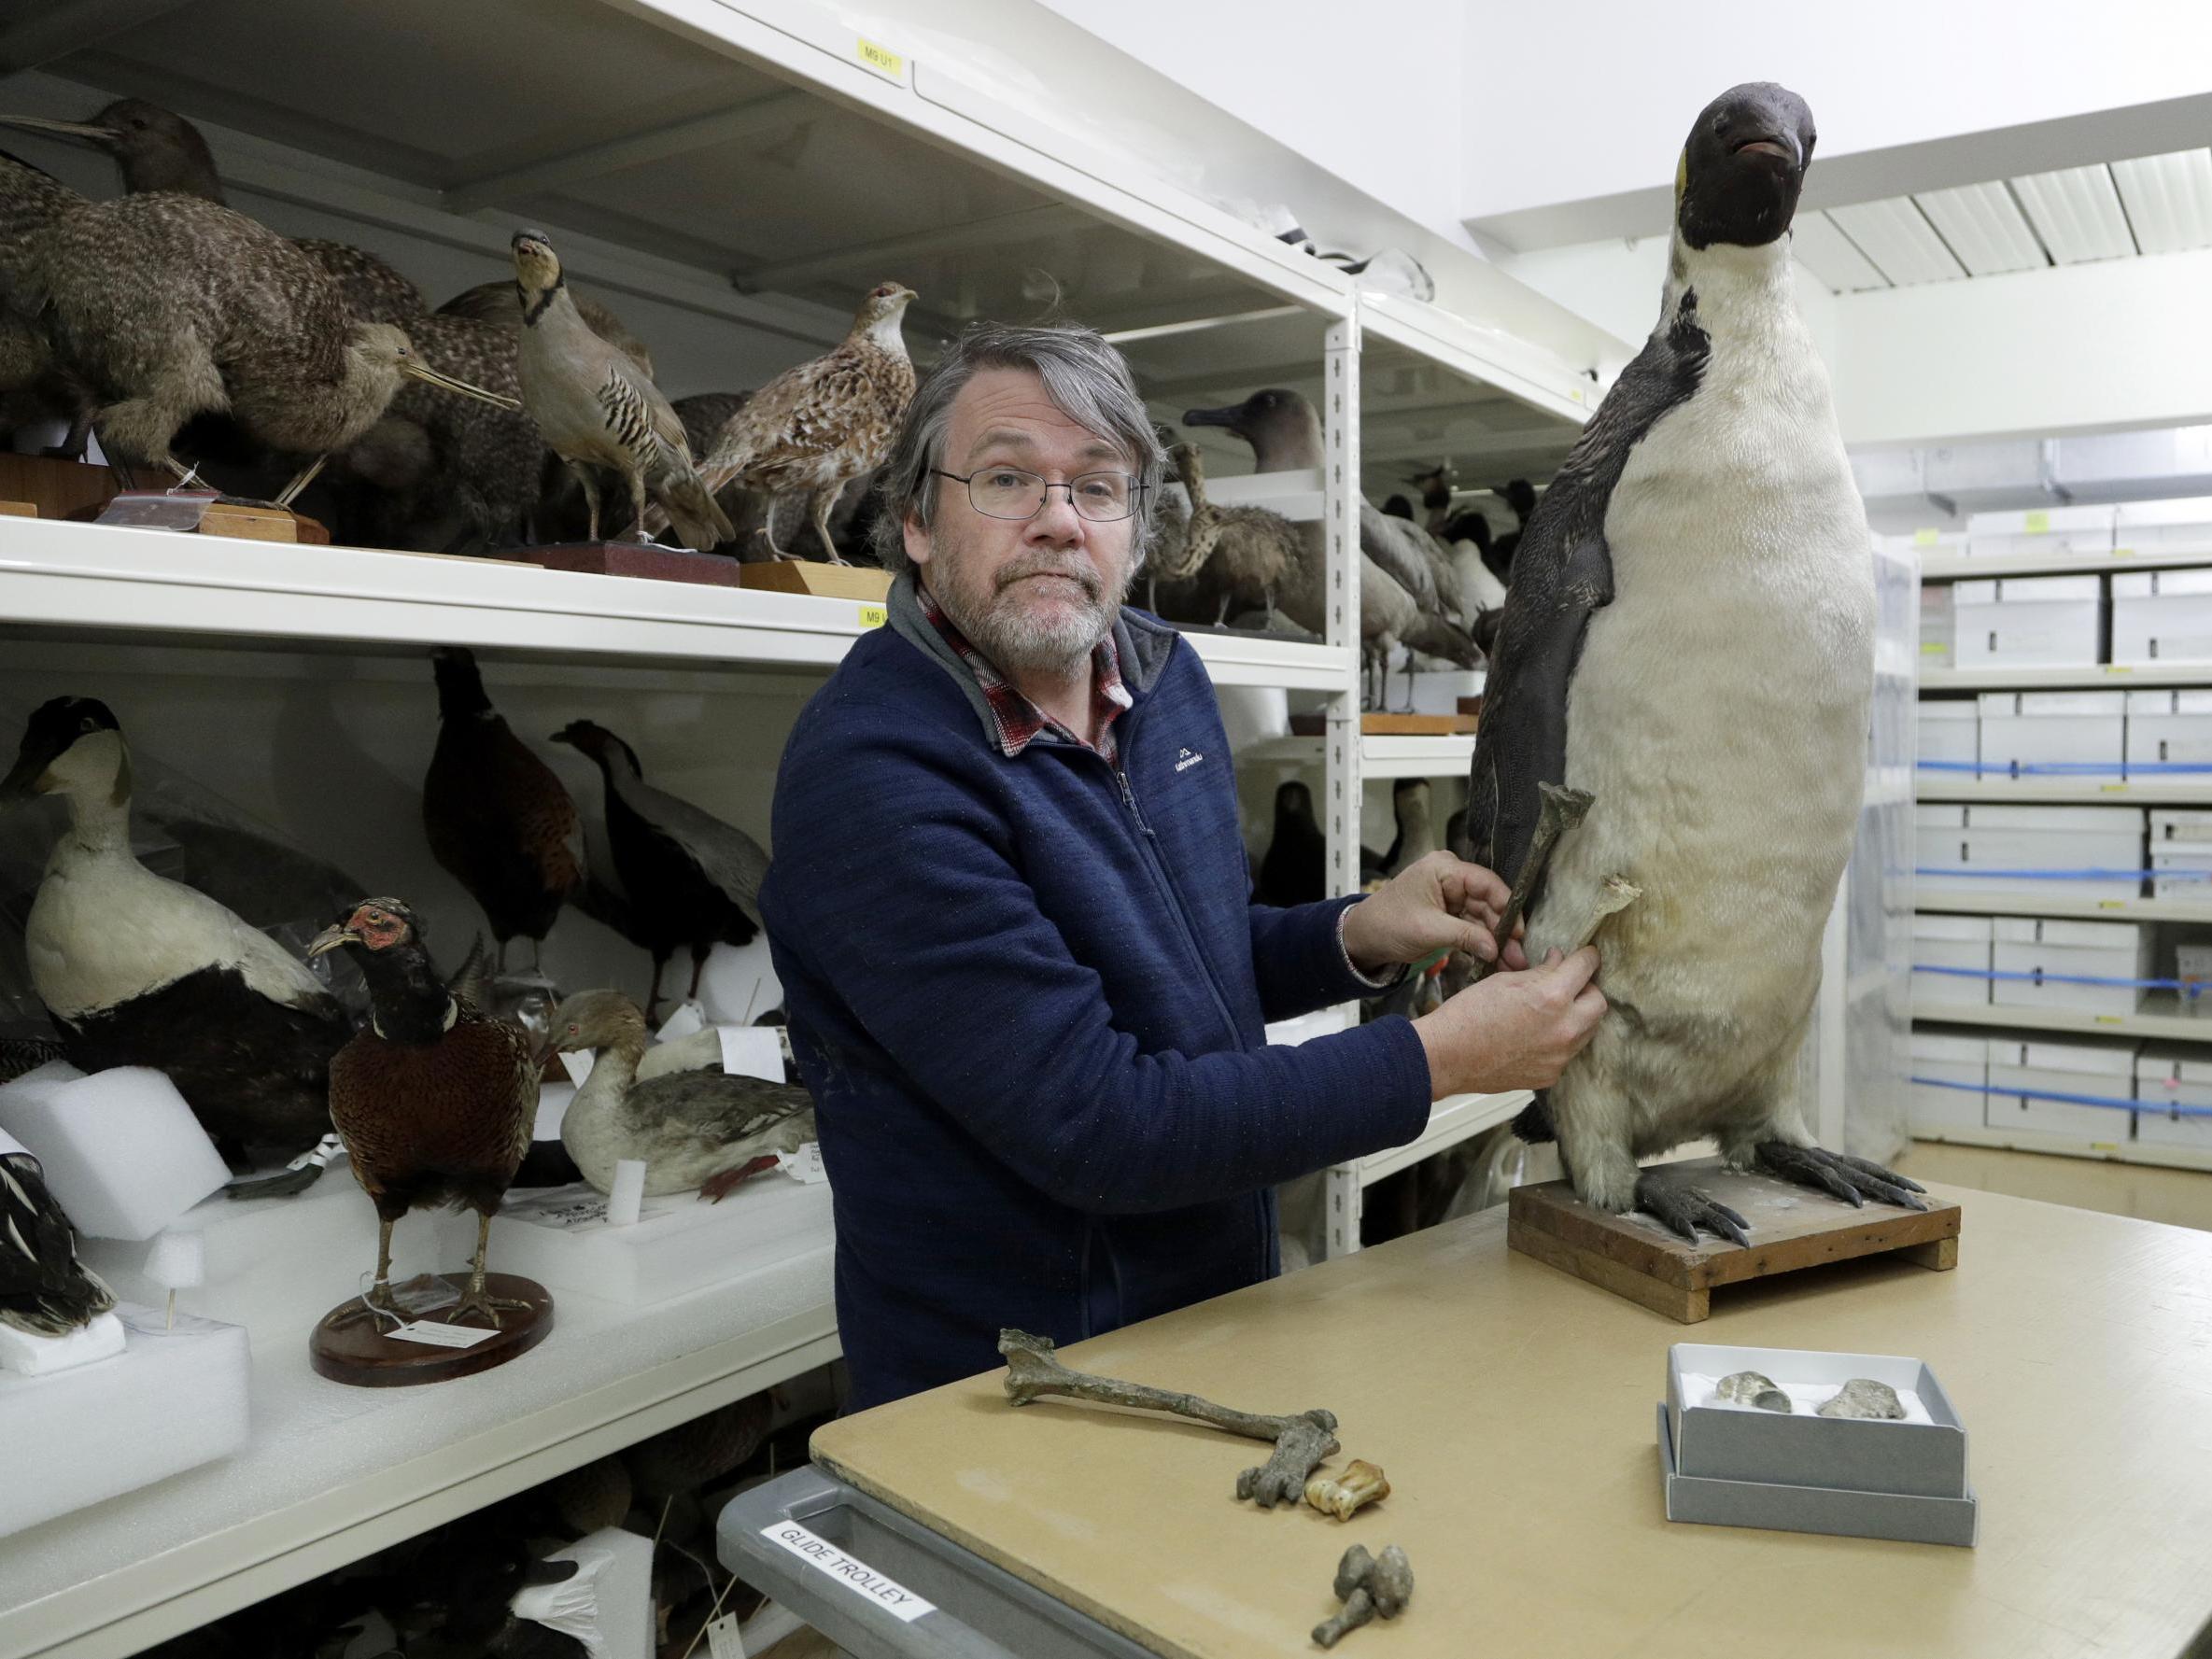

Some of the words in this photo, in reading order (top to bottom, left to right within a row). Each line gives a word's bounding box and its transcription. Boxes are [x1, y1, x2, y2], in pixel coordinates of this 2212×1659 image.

[867, 612, 880, 624] M9
[781, 1528, 835, 1561] GLIDE
[830, 1557, 913, 1606] TROLLEY
